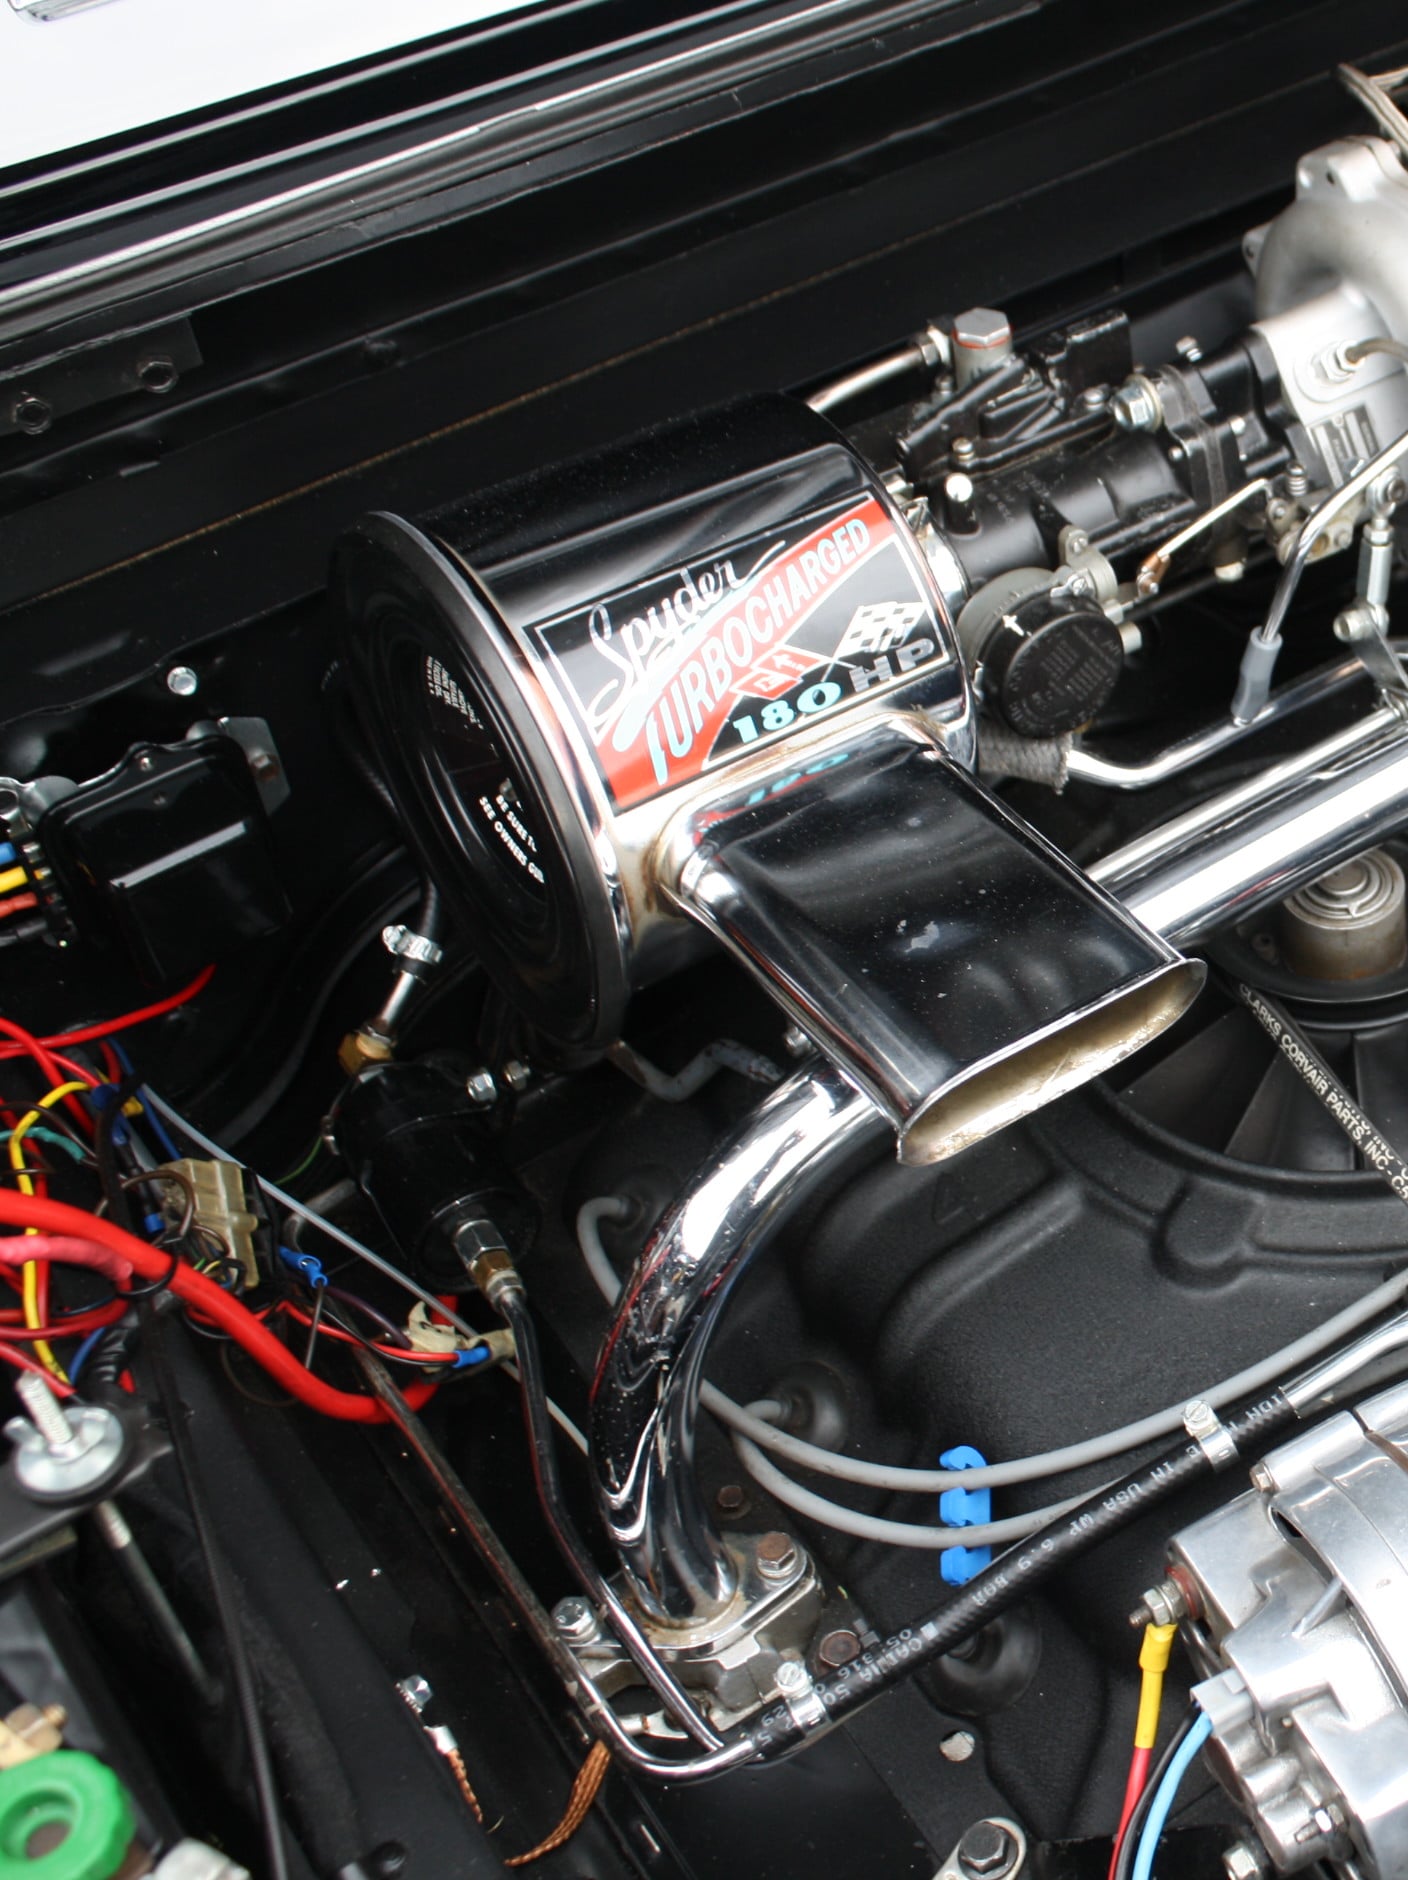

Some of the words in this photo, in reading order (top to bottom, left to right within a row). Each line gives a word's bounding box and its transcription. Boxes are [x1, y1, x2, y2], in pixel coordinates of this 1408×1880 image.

[590, 541, 786, 722] Spyder
[645, 518, 871, 786] TURBOCHARGED
[733, 681, 842, 744] 180
[849, 637, 935, 693] HP
[1238, 982, 1284, 1036] CLARKS
[1279, 1033, 1331, 1095] CORVAIR
[1363, 1140, 1390, 1170] INC
[1102, 1481, 1144, 1515] USA
